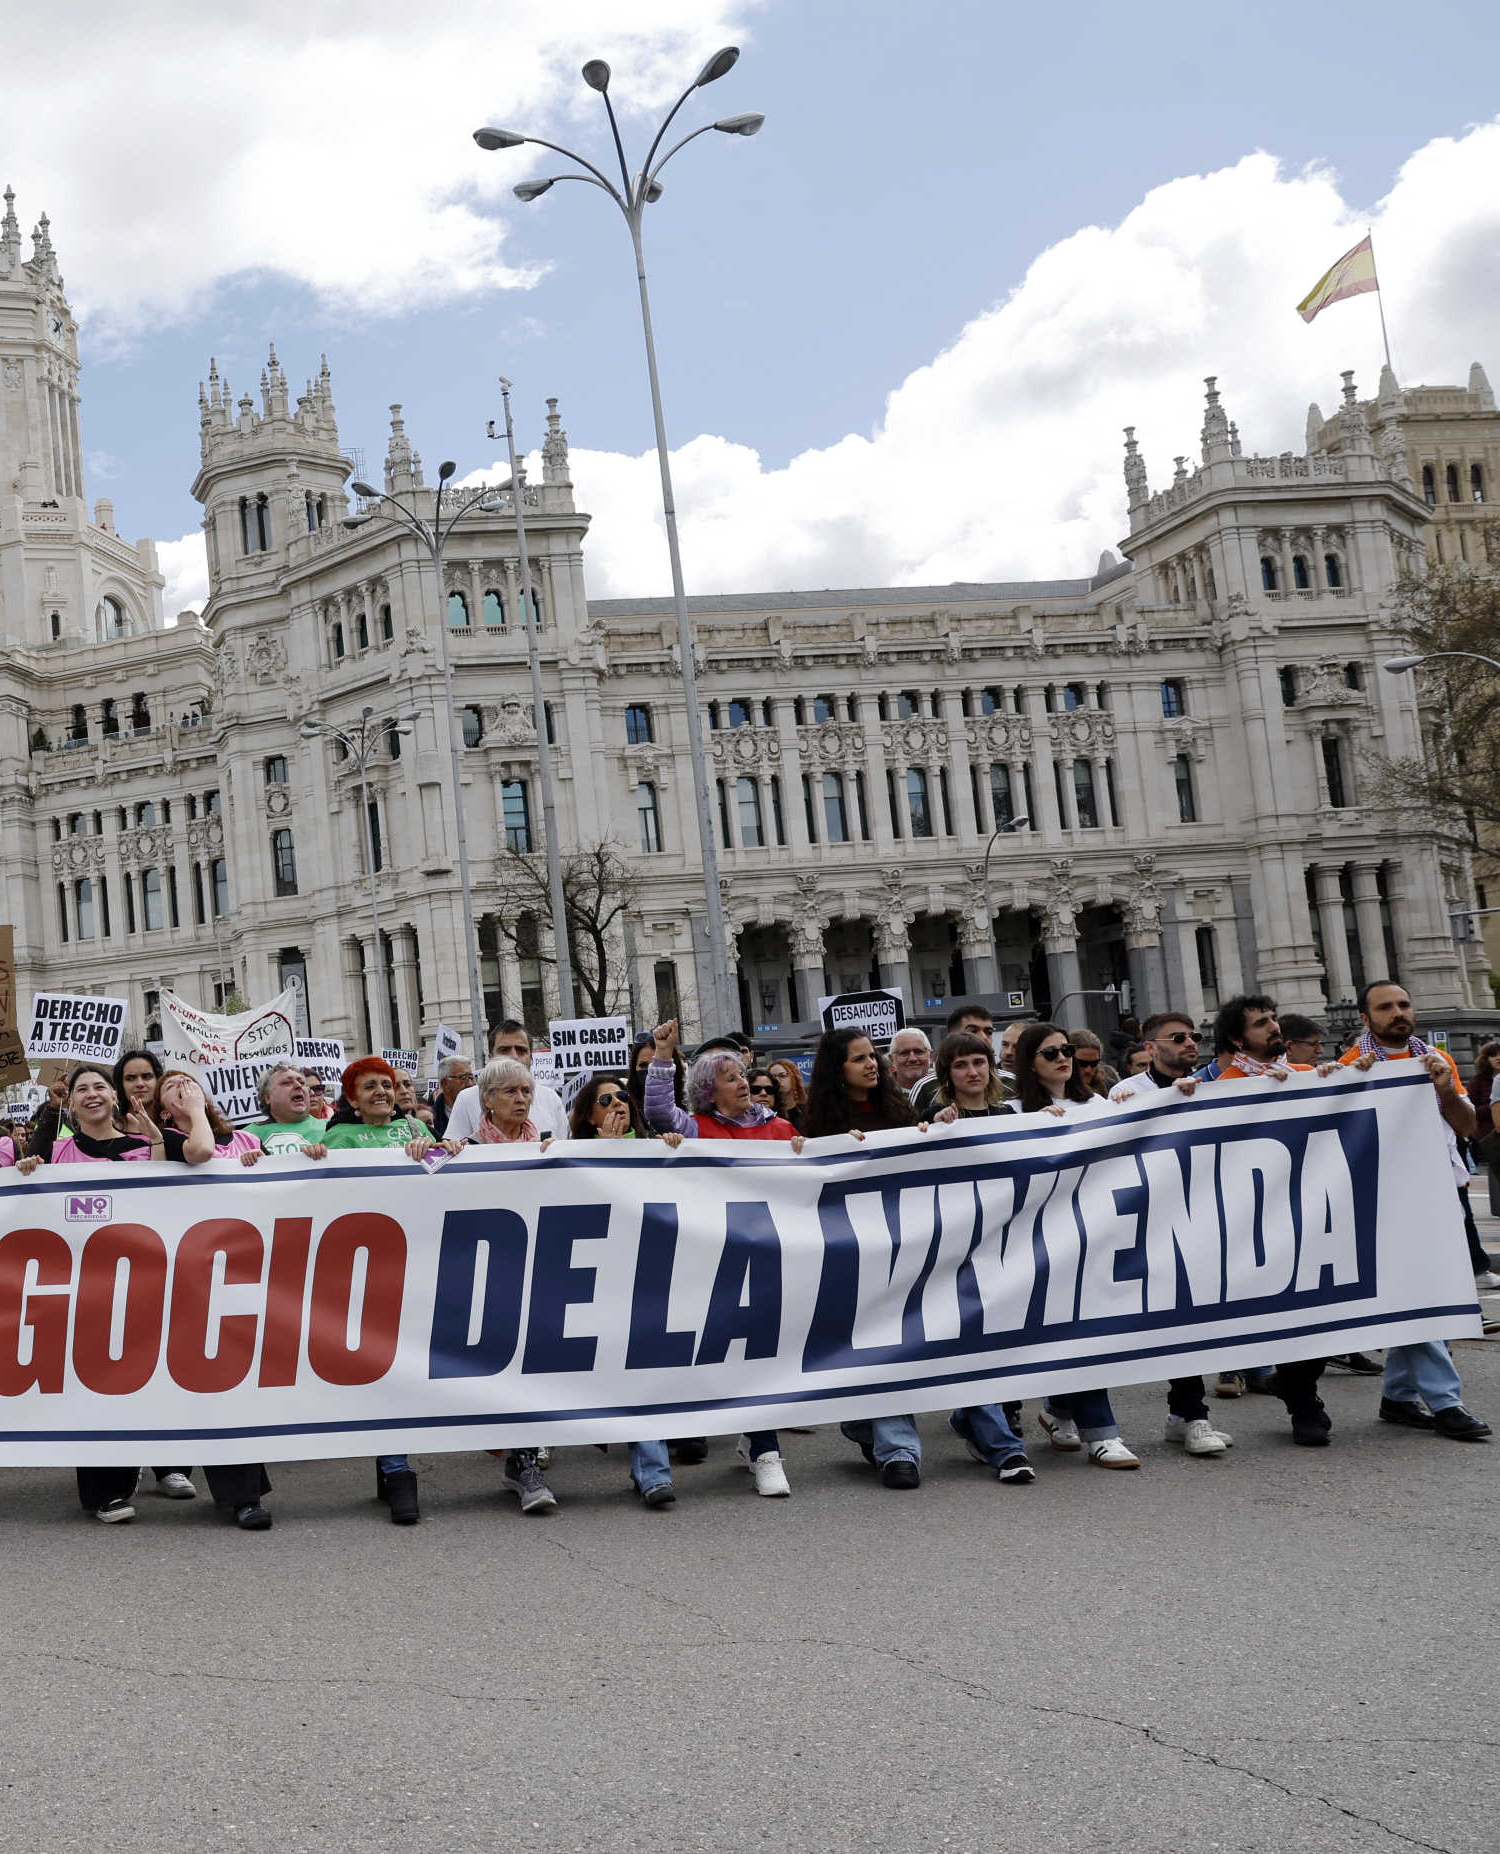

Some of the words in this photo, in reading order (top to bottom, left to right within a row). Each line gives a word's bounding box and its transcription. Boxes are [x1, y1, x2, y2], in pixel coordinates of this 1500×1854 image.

[35, 998, 123, 1025] DERECHO
[834, 1001, 895, 1021] DESAHUCIOS
[31, 1021, 44, 1041] A
[49, 1022, 119, 1046] TECHO
[180, 1021, 221, 1039] FAMILIA
[248, 1016, 281, 1044] STOP
[553, 1029, 577, 1046] SIN
[580, 1027, 626, 1045] CASA?
[28, 1042, 36, 1052] A
[38, 1042, 69, 1053] JUSTO
[72, 1043, 116, 1059] PRECIO!
[175, 1050, 187, 1061] LA
[239, 1044, 288, 1060] DESAHUCIOS
[296, 1041, 340, 1059] DERECHO
[383, 1051, 417, 1061] DERECHO
[389, 1060, 416, 1070] TECHO
[554, 1053, 564, 1069] A
[566, 1052, 583, 1068] LA
[584, 1050, 627, 1067] CALLE!
[429, 1204, 611, 1380] DE
[625, 1202, 782, 1370] LA
[845, 1129, 1359, 1350] VIVIENDA
